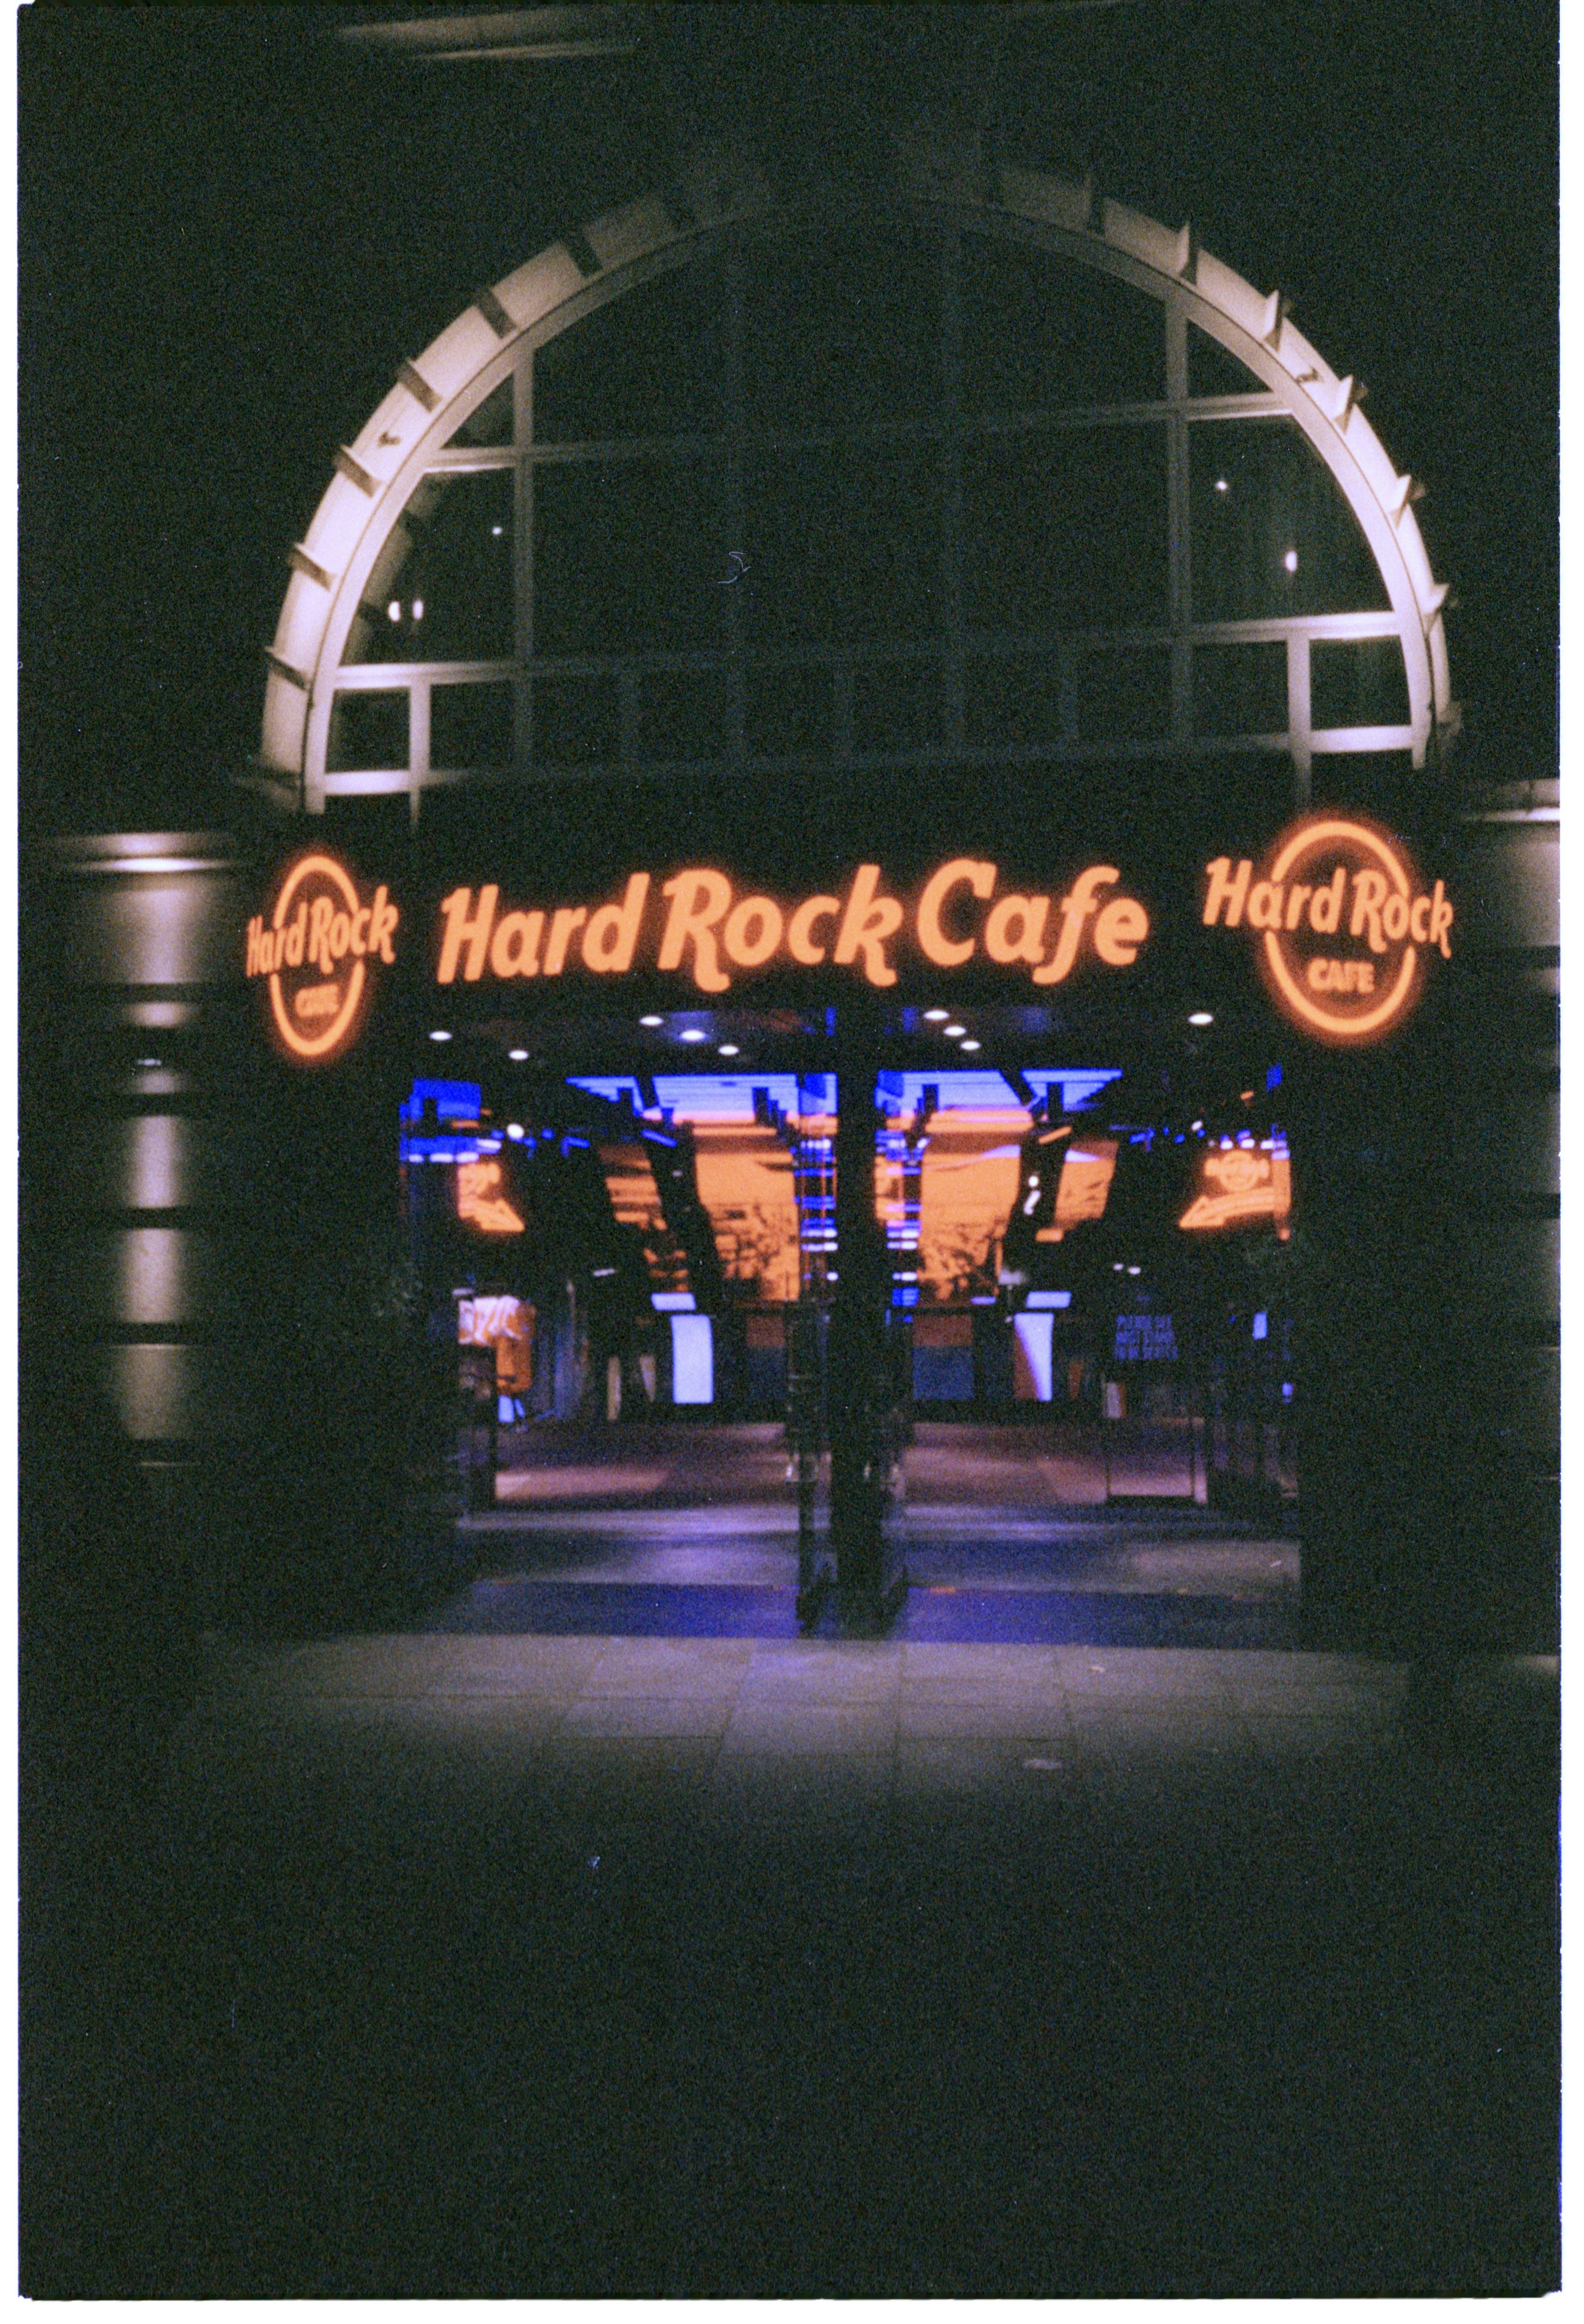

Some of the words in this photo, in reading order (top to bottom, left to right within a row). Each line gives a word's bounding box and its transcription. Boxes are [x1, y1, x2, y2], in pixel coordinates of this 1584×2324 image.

[246, 901, 309, 978] Hard
[308, 884, 399, 975] Rock
[437, 872, 650, 984] Hard
[658, 864, 904, 993] Rock
[916, 858, 1149, 985] Cafe
[1203, 856, 1346, 934] Hard
[1350, 869, 1454, 959] Rock
[1307, 957, 1375, 993] CAFE
